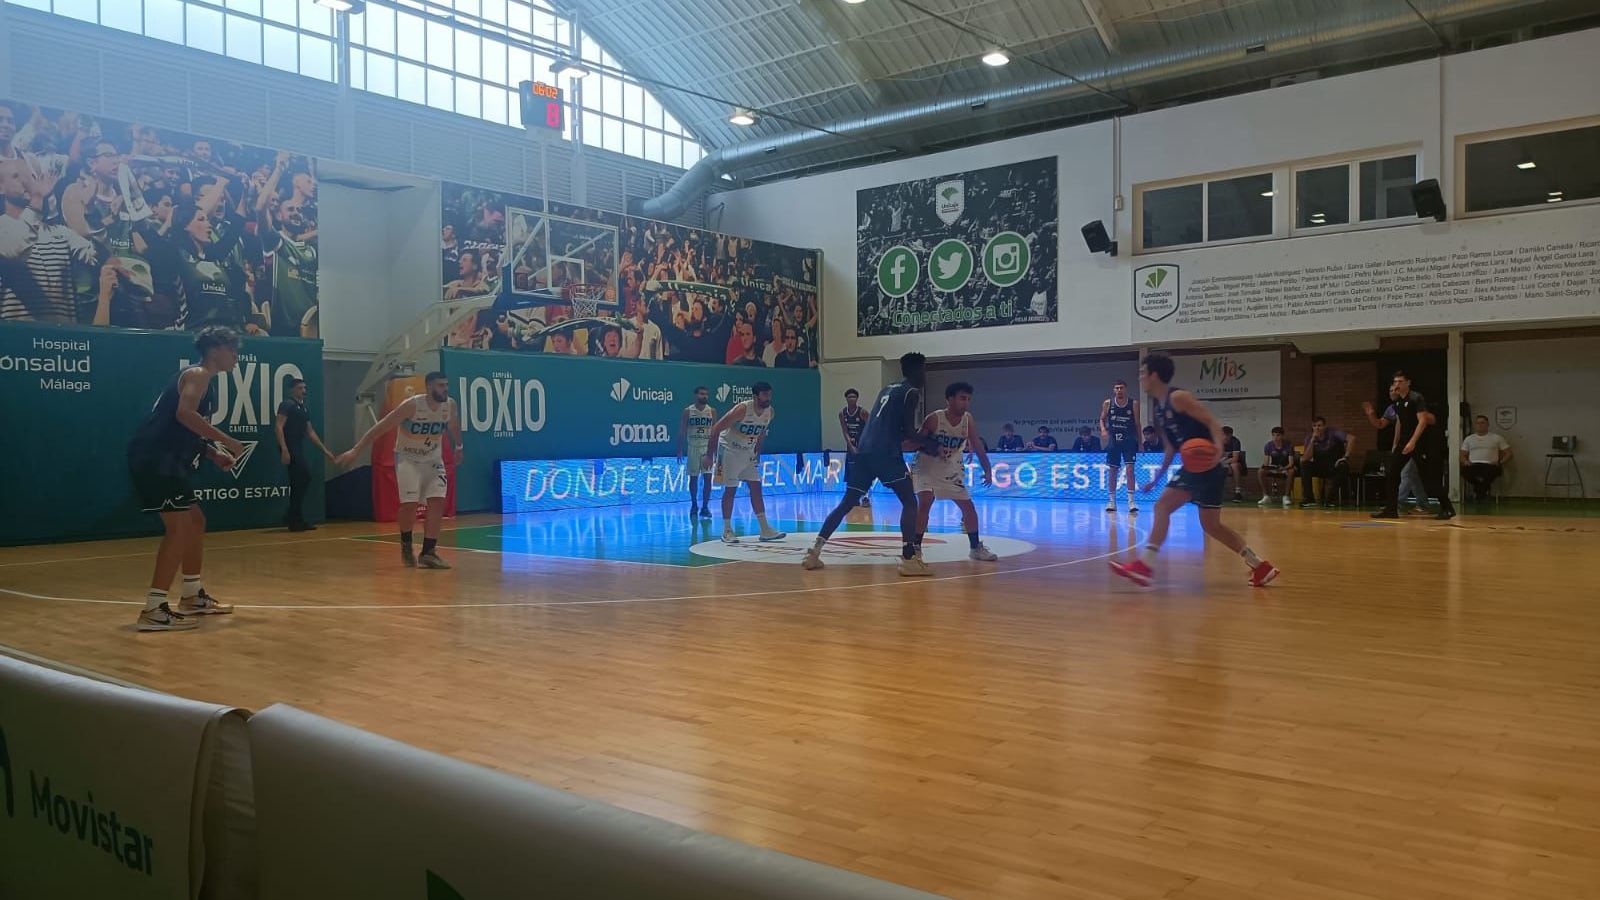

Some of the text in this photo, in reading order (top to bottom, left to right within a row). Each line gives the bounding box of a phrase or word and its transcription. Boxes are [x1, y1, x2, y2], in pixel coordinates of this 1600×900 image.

[547, 102, 560, 127] 8
[893, 299, 1013, 327] Conectados a ti
[33, 337, 90, 352] Hospital
[0, 355, 91, 373] ónsalud
[1199, 356, 1247, 385] Mijas
[40, 378, 91, 393] Málaga
[732, 386, 753, 395] Funda
[632, 387, 673, 405] Unicaja
[876, 395, 890, 418] 7
[424, 437, 432, 447] 4
[1115, 433, 1123, 441] 12
[525, 464, 635, 501] DONDE
[761, 460, 786, 487] EL
[793, 458, 841, 486] MAR
[193, 488, 240, 501] RTIGO
[29, 769, 153, 877] Movistar
